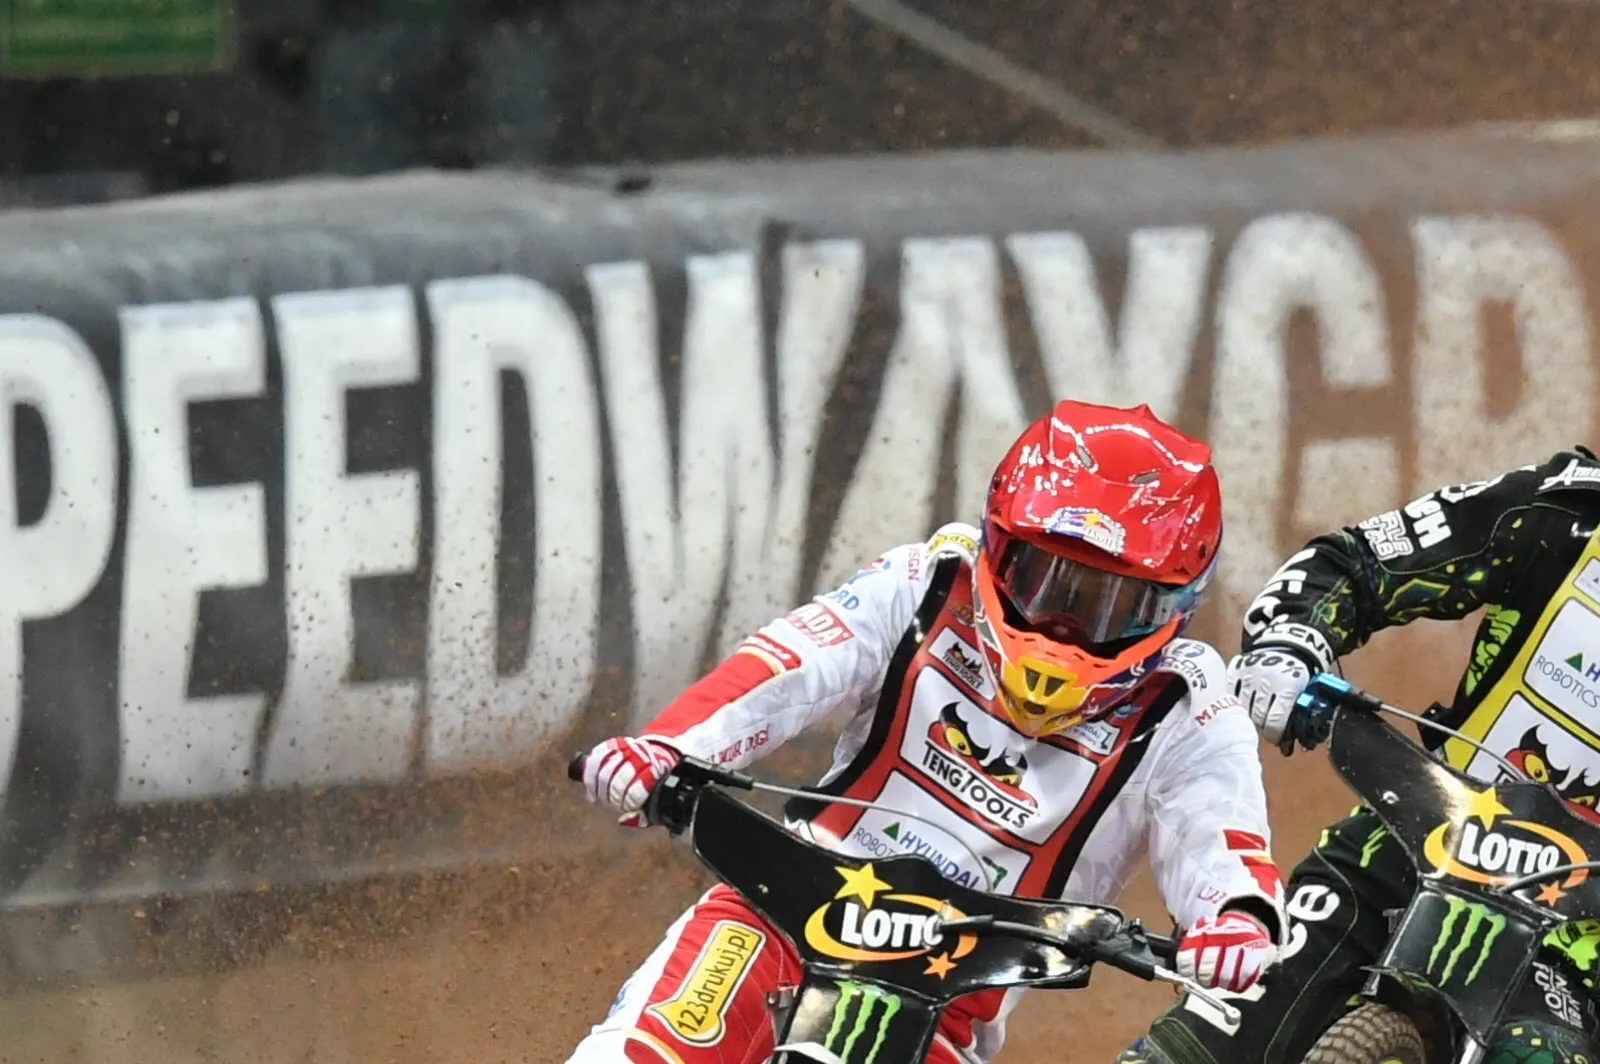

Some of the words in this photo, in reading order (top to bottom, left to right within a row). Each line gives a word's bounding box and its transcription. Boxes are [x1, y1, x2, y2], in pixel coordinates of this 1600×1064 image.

[922, 740, 1036, 829] TENGTOOLS
[899, 830, 982, 890] HYUNDAI
[1458, 822, 1560, 875] LOTTO
[841, 901, 944, 949] LOTTO
[676, 927, 751, 1033] 123drukuj.pl
